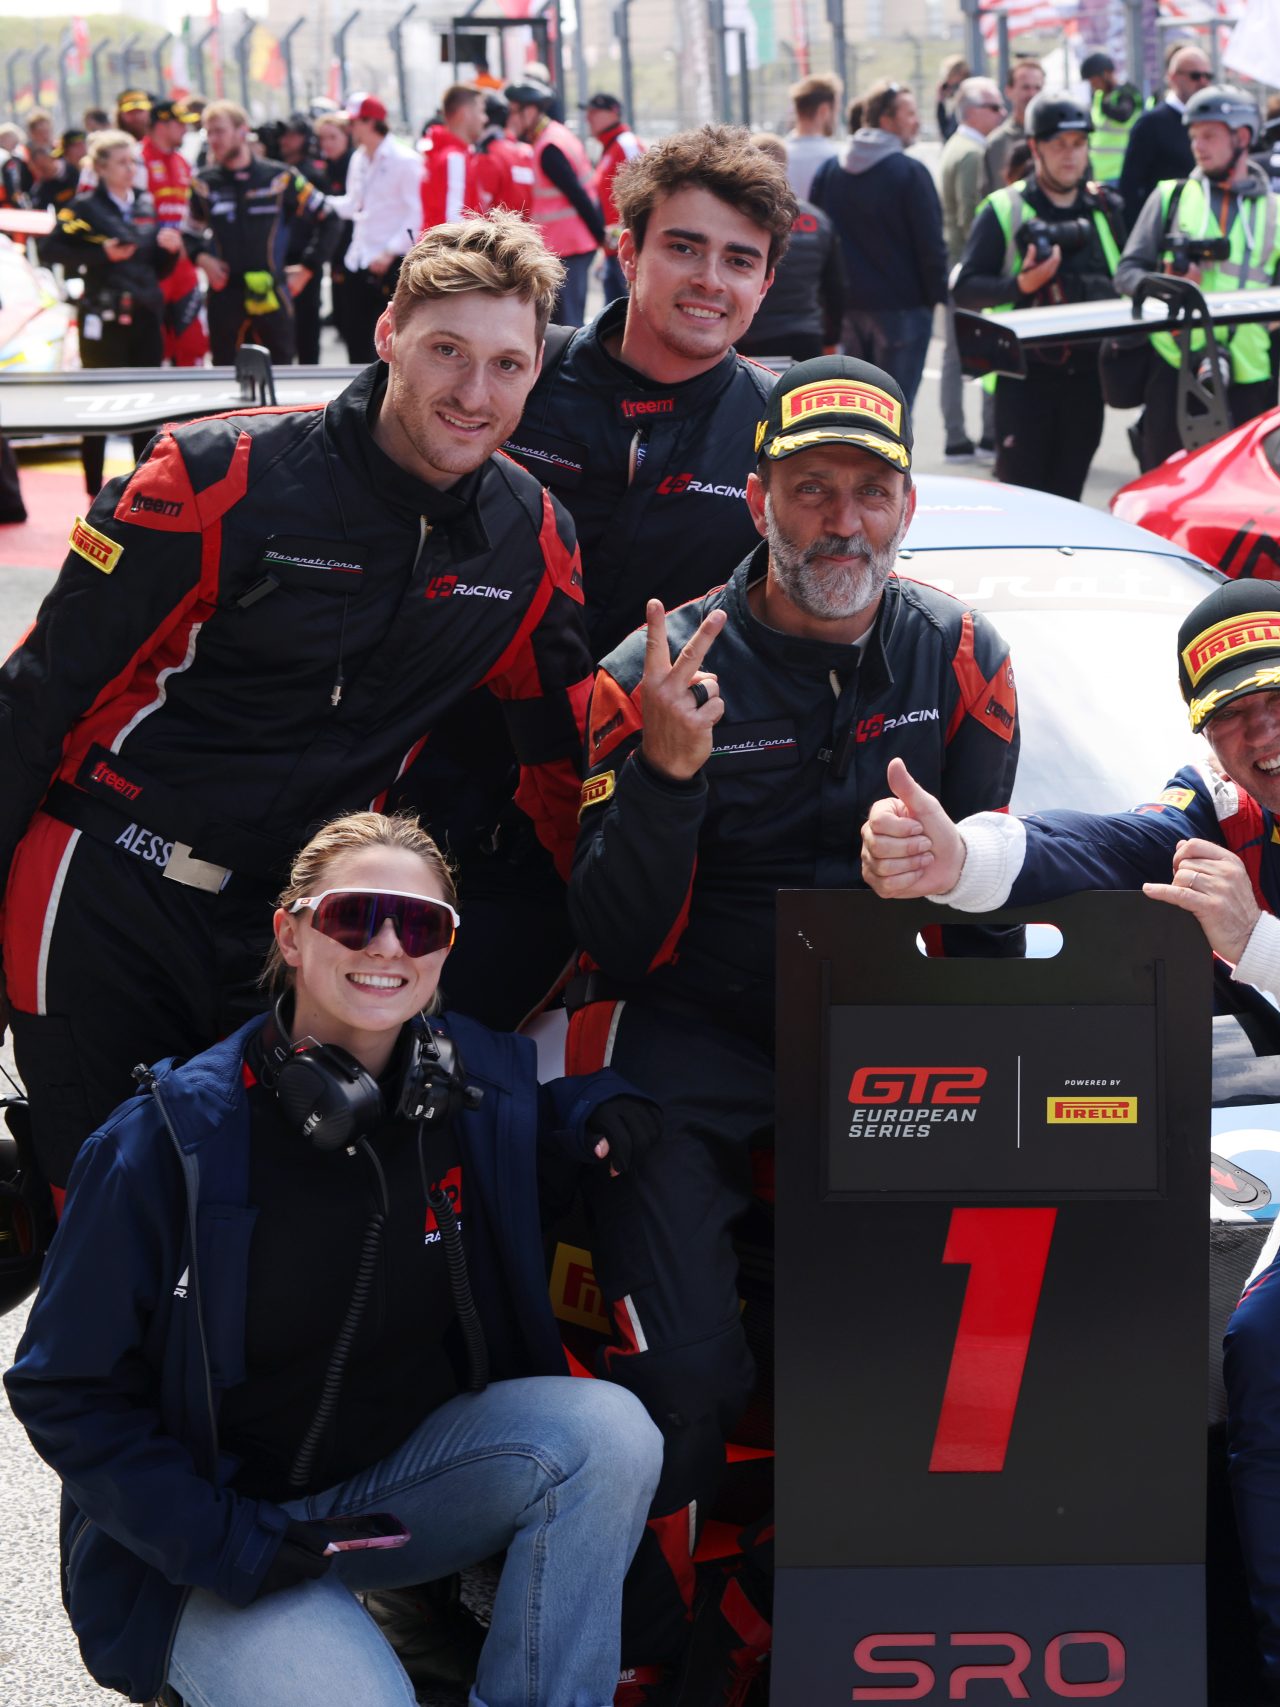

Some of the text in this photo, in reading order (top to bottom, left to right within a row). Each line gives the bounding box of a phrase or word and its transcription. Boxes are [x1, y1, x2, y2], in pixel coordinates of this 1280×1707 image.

[620, 399, 674, 418] freem
[790, 386, 895, 423] PIRELLI
[130, 491, 184, 518] freem
[265, 550, 363, 570] Maserati Corse
[453, 584, 513, 600] RACING
[882, 708, 939, 732] RACIN
[712, 741, 757, 752] aserati
[91, 761, 144, 800] freem
[848, 1067, 988, 1104] GT2
[852, 1109, 977, 1122] EUROPEAN
[1055, 1102, 1130, 1119] PIRELLI
[849, 1125, 931, 1138] SERIES
[928, 1207, 1058, 1473] 1
[852, 1631, 1127, 1700] SRO
